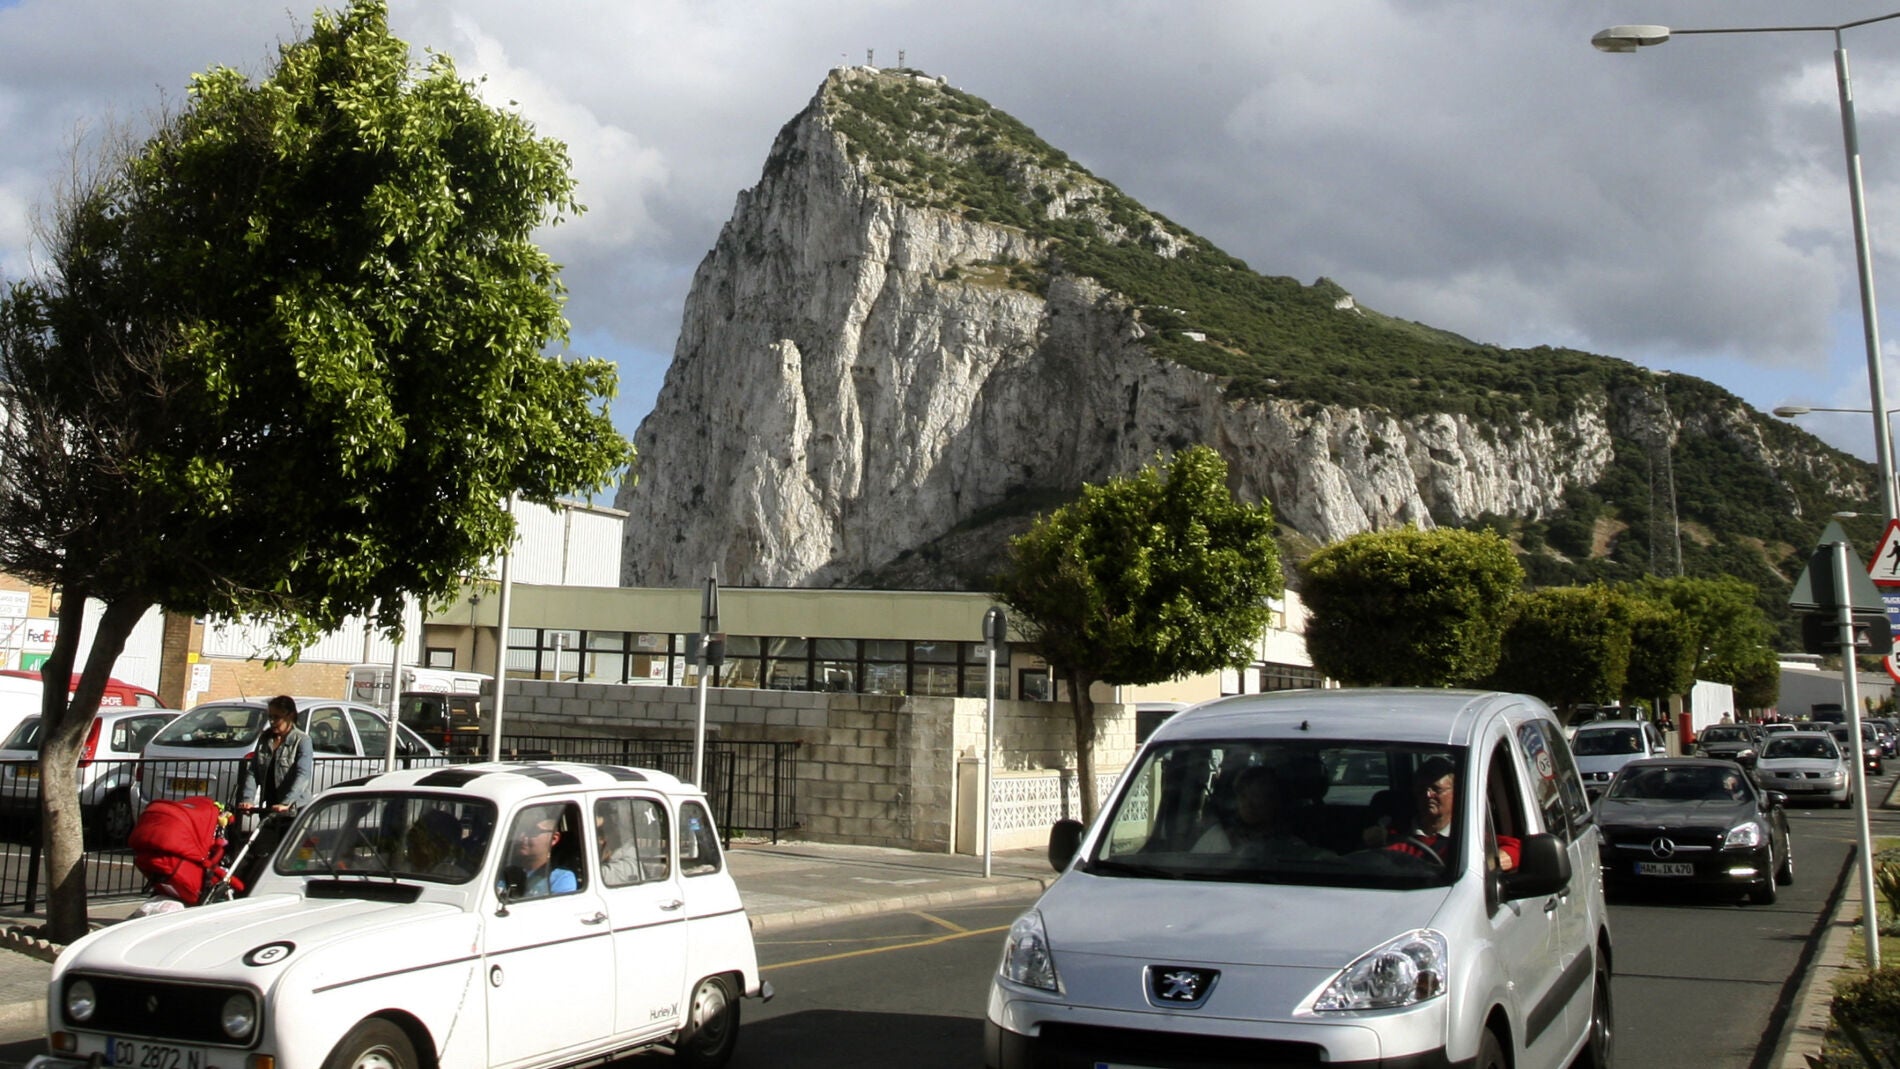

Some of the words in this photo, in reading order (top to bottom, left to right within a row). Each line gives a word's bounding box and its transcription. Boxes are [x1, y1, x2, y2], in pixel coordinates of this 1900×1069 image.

[261, 949, 280, 959] 8
[141, 1044, 181, 1069] 2872
[187, 1050, 200, 1069] N
